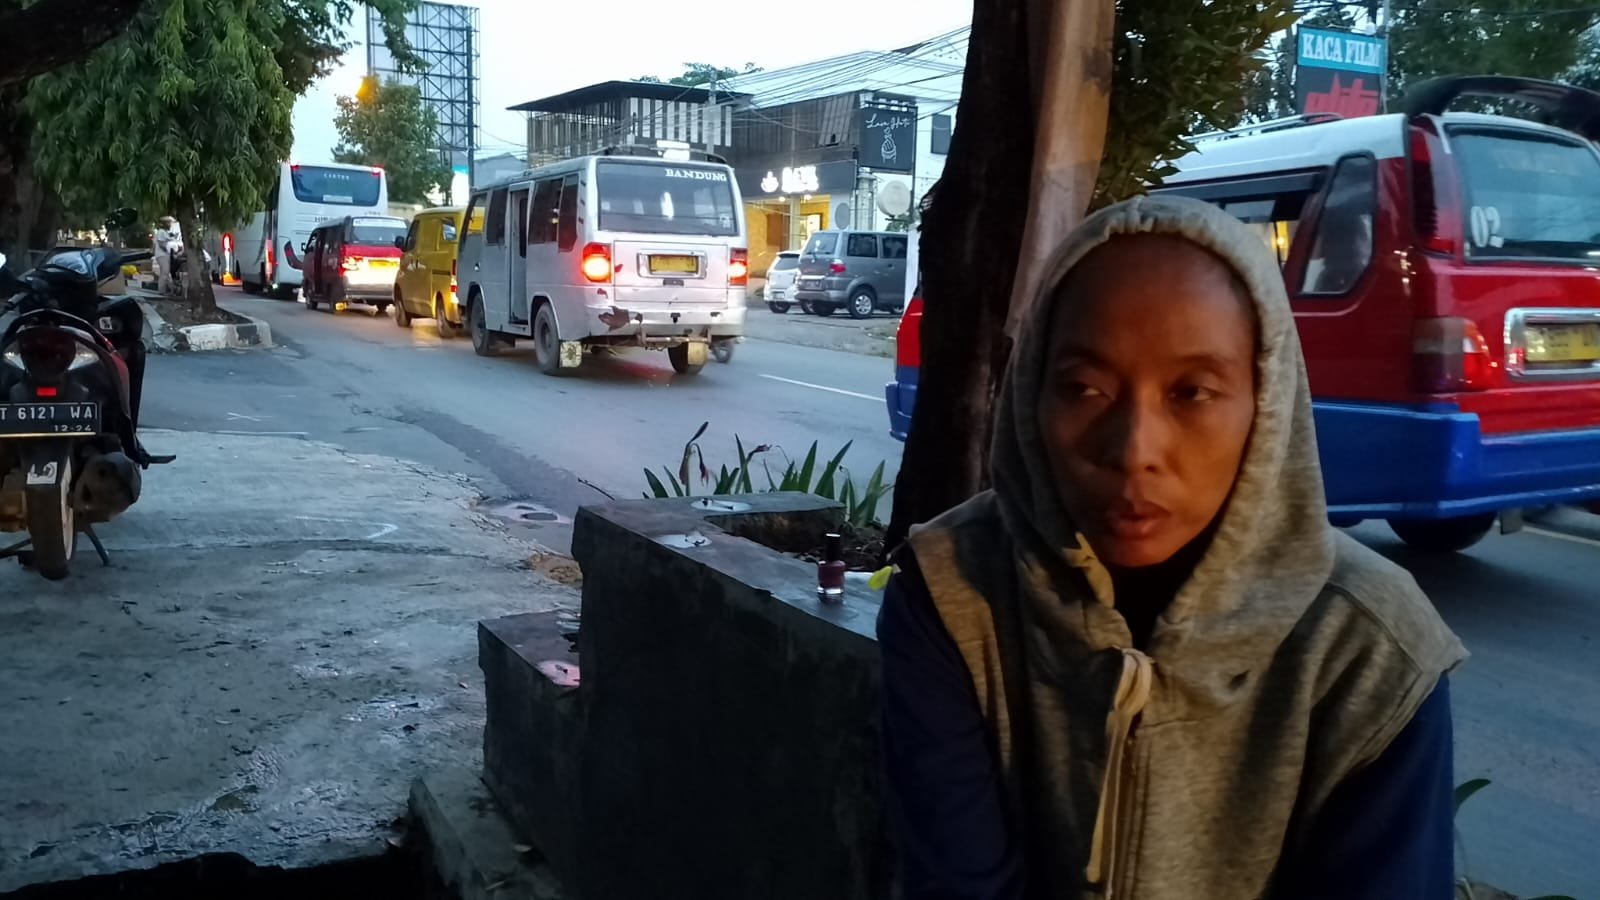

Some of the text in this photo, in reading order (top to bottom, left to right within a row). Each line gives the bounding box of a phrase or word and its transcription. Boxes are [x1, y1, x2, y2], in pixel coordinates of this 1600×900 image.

[1302, 33, 1382, 67] KACA FILM
[665, 168, 727, 181] BANDUNG
[18, 406, 55, 420] 6121
[70, 406, 93, 419] WA
